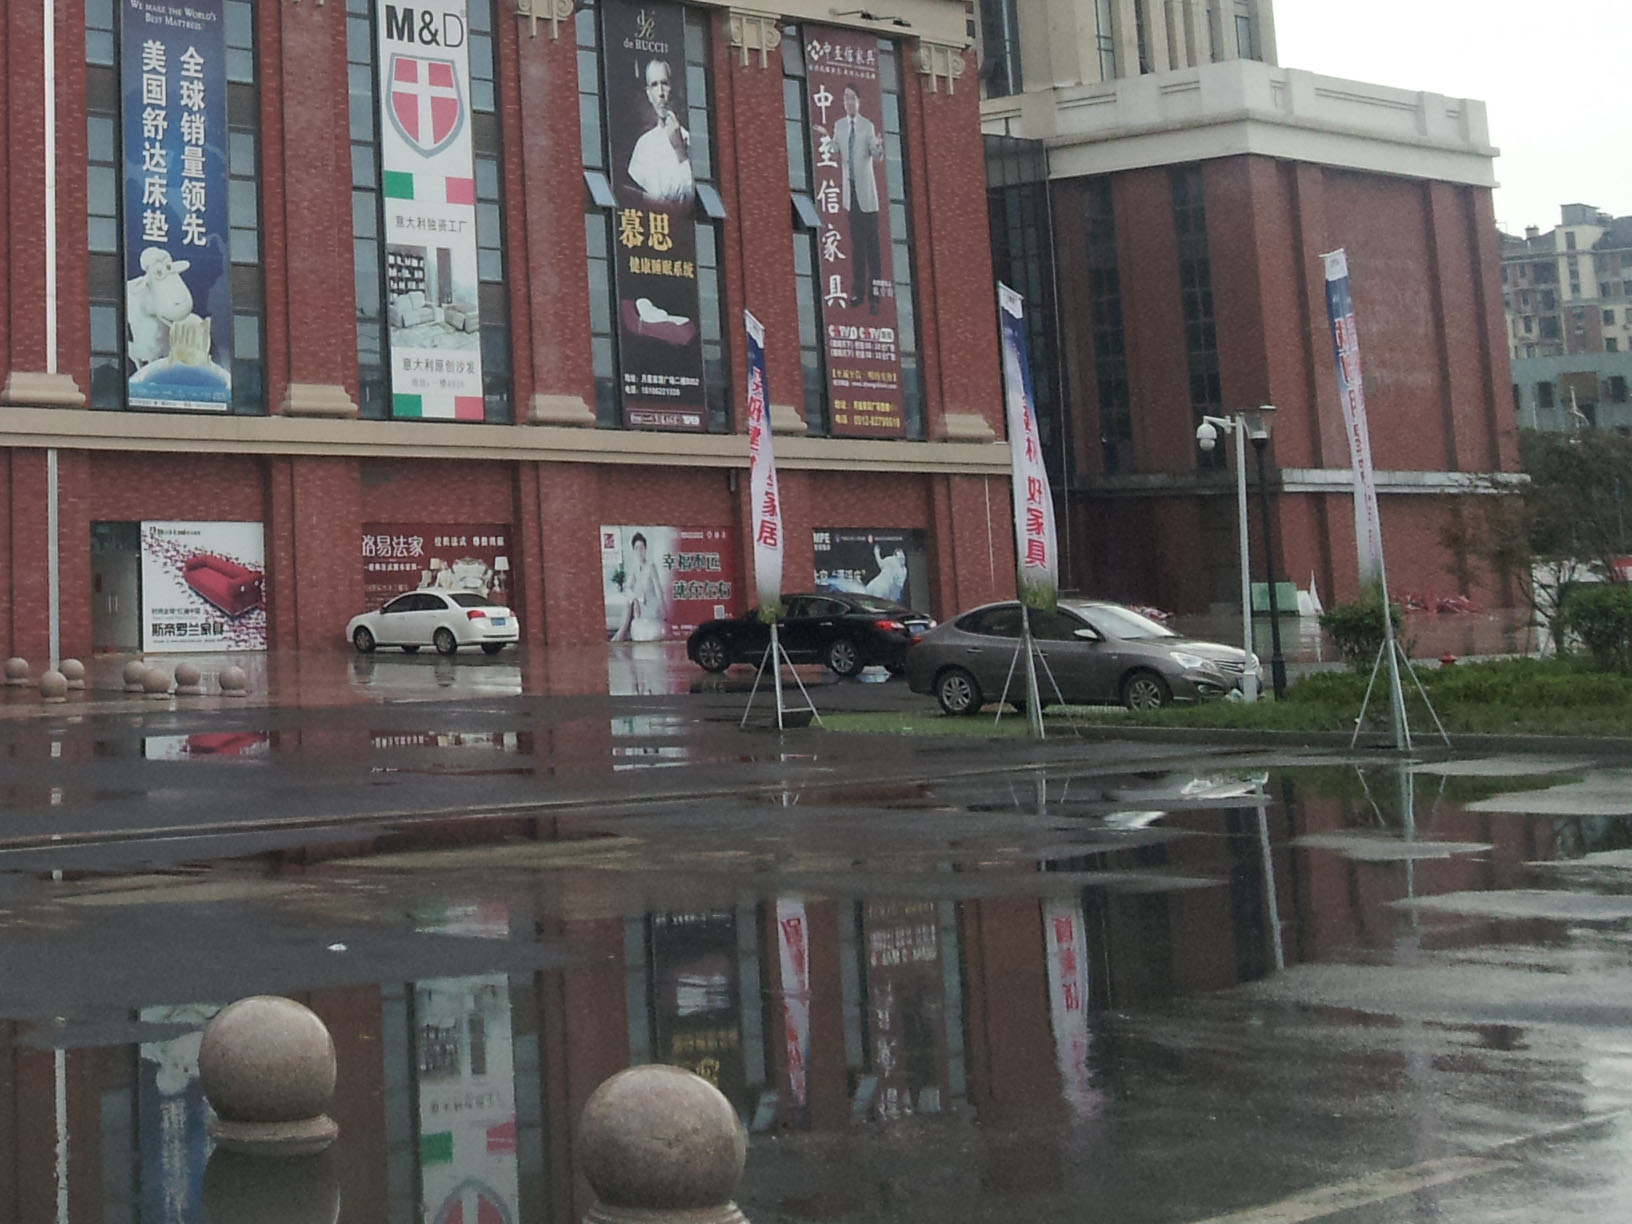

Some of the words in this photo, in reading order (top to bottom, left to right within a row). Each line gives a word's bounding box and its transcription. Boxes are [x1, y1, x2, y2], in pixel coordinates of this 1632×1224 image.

[385, 4, 464, 48] M&D
[142, 40, 168, 243] 美国舒达床垫
[180, 45, 207, 246] 全球销量领先
[617, 208, 673, 251] 慕思
[812, 84, 848, 309] 中至信家具
